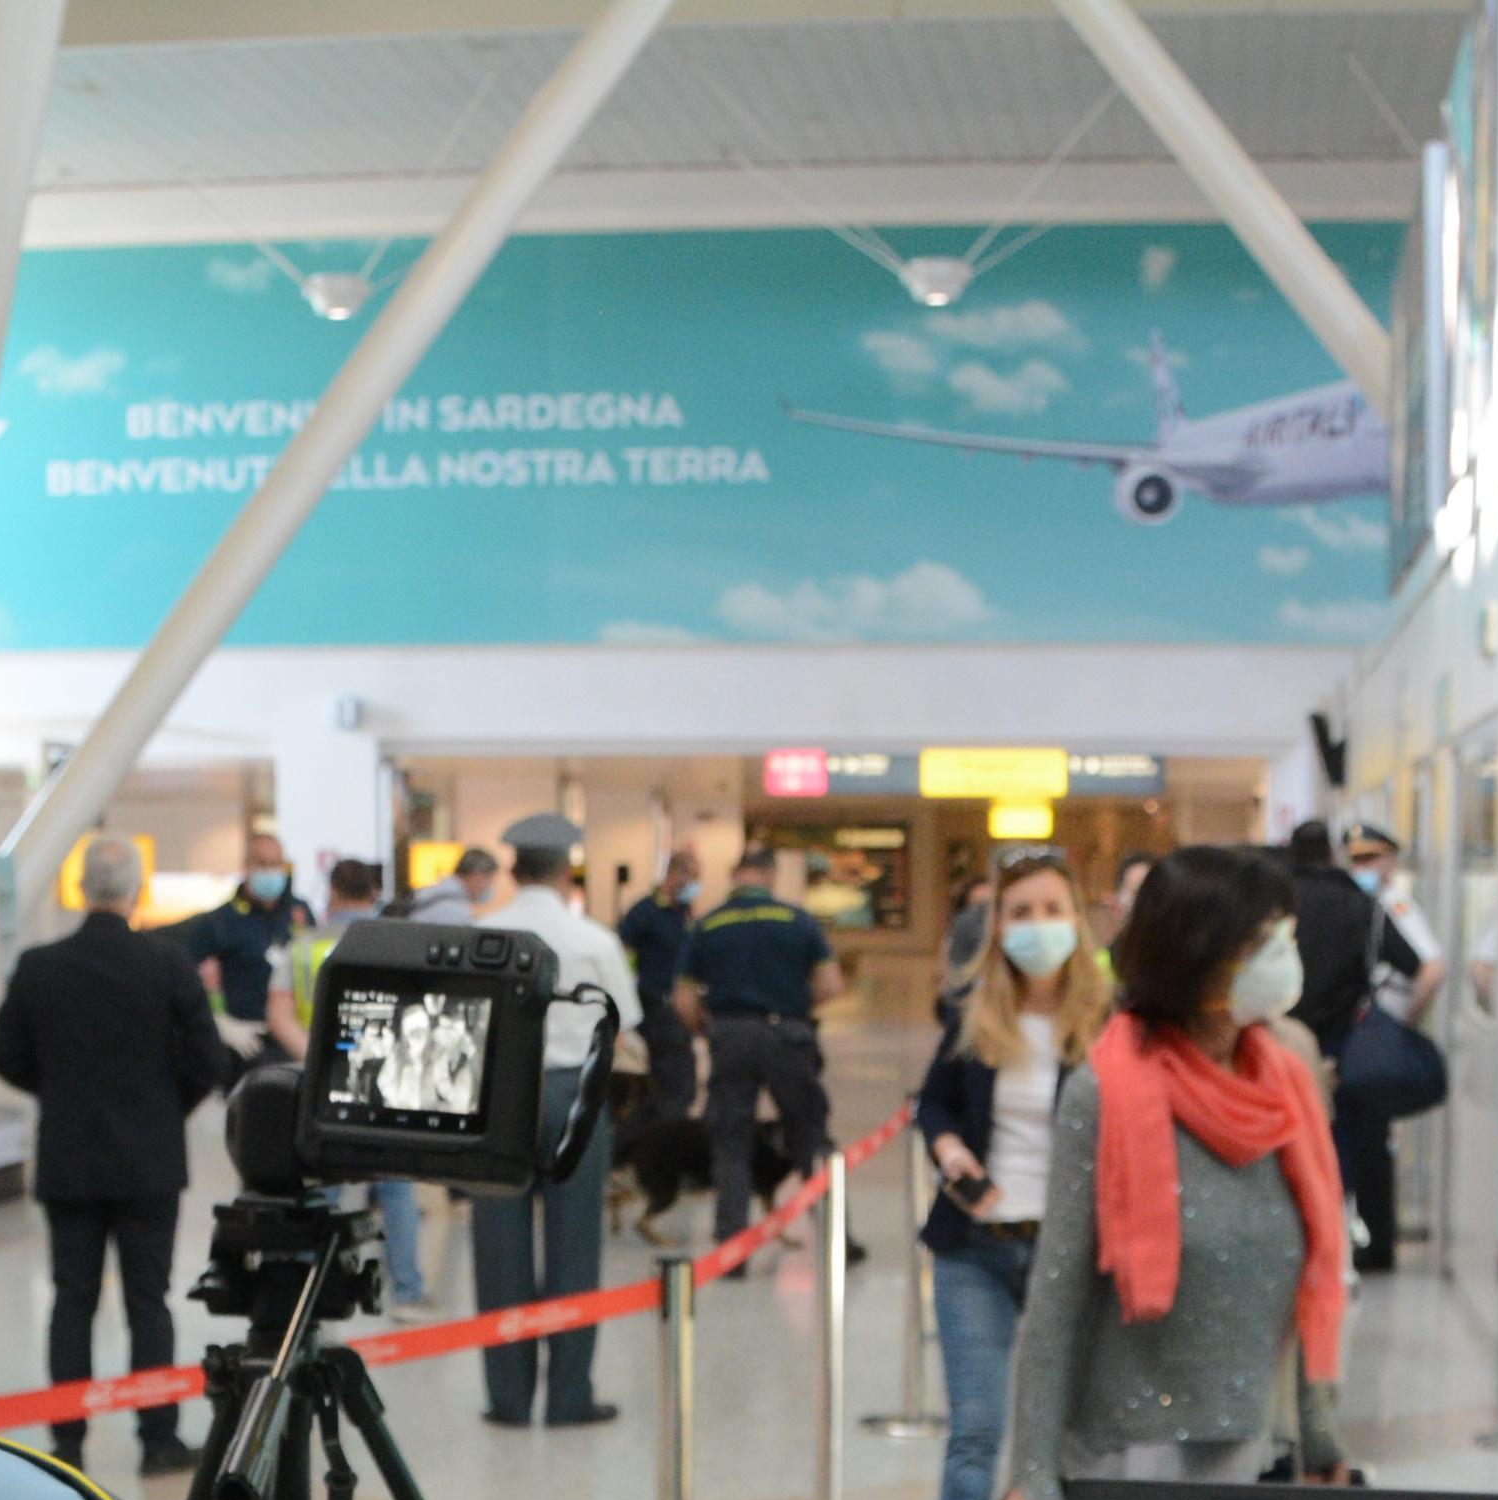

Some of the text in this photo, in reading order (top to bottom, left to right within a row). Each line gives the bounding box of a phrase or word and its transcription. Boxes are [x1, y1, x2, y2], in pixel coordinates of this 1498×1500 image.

[126, 393, 686, 439] BENVEN IN SARDEGNA
[46, 453, 283, 497] BENVENUT
[436, 447, 619, 488] NOSTRA
[622, 445, 771, 485] TERRA
